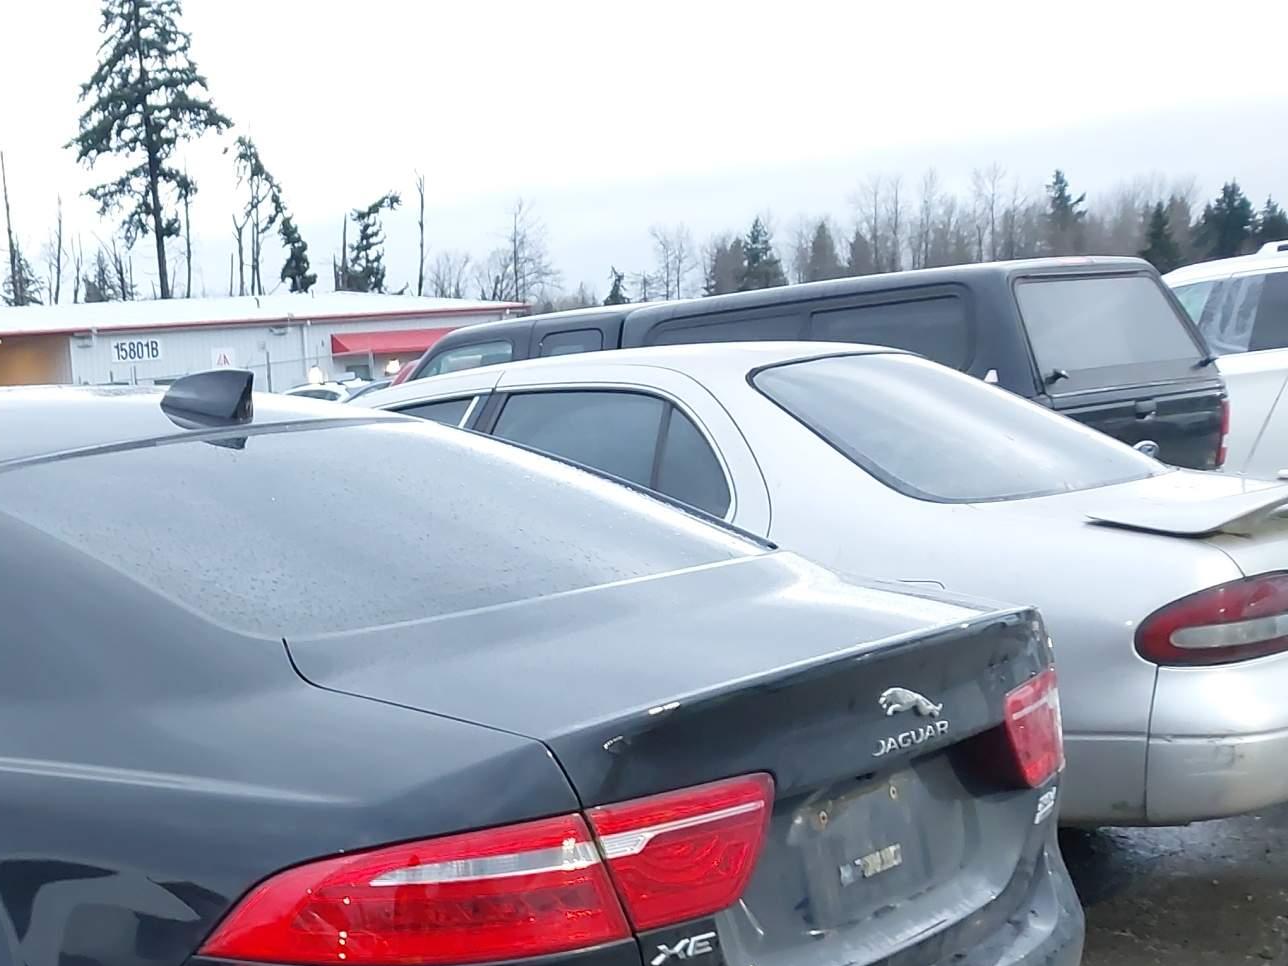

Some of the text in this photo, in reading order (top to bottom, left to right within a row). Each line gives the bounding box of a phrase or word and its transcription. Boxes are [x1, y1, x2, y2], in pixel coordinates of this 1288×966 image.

[114, 340, 159, 360] 15801B
[872, 720, 949, 756] JAGUAR
[650, 931, 717, 966] XE
